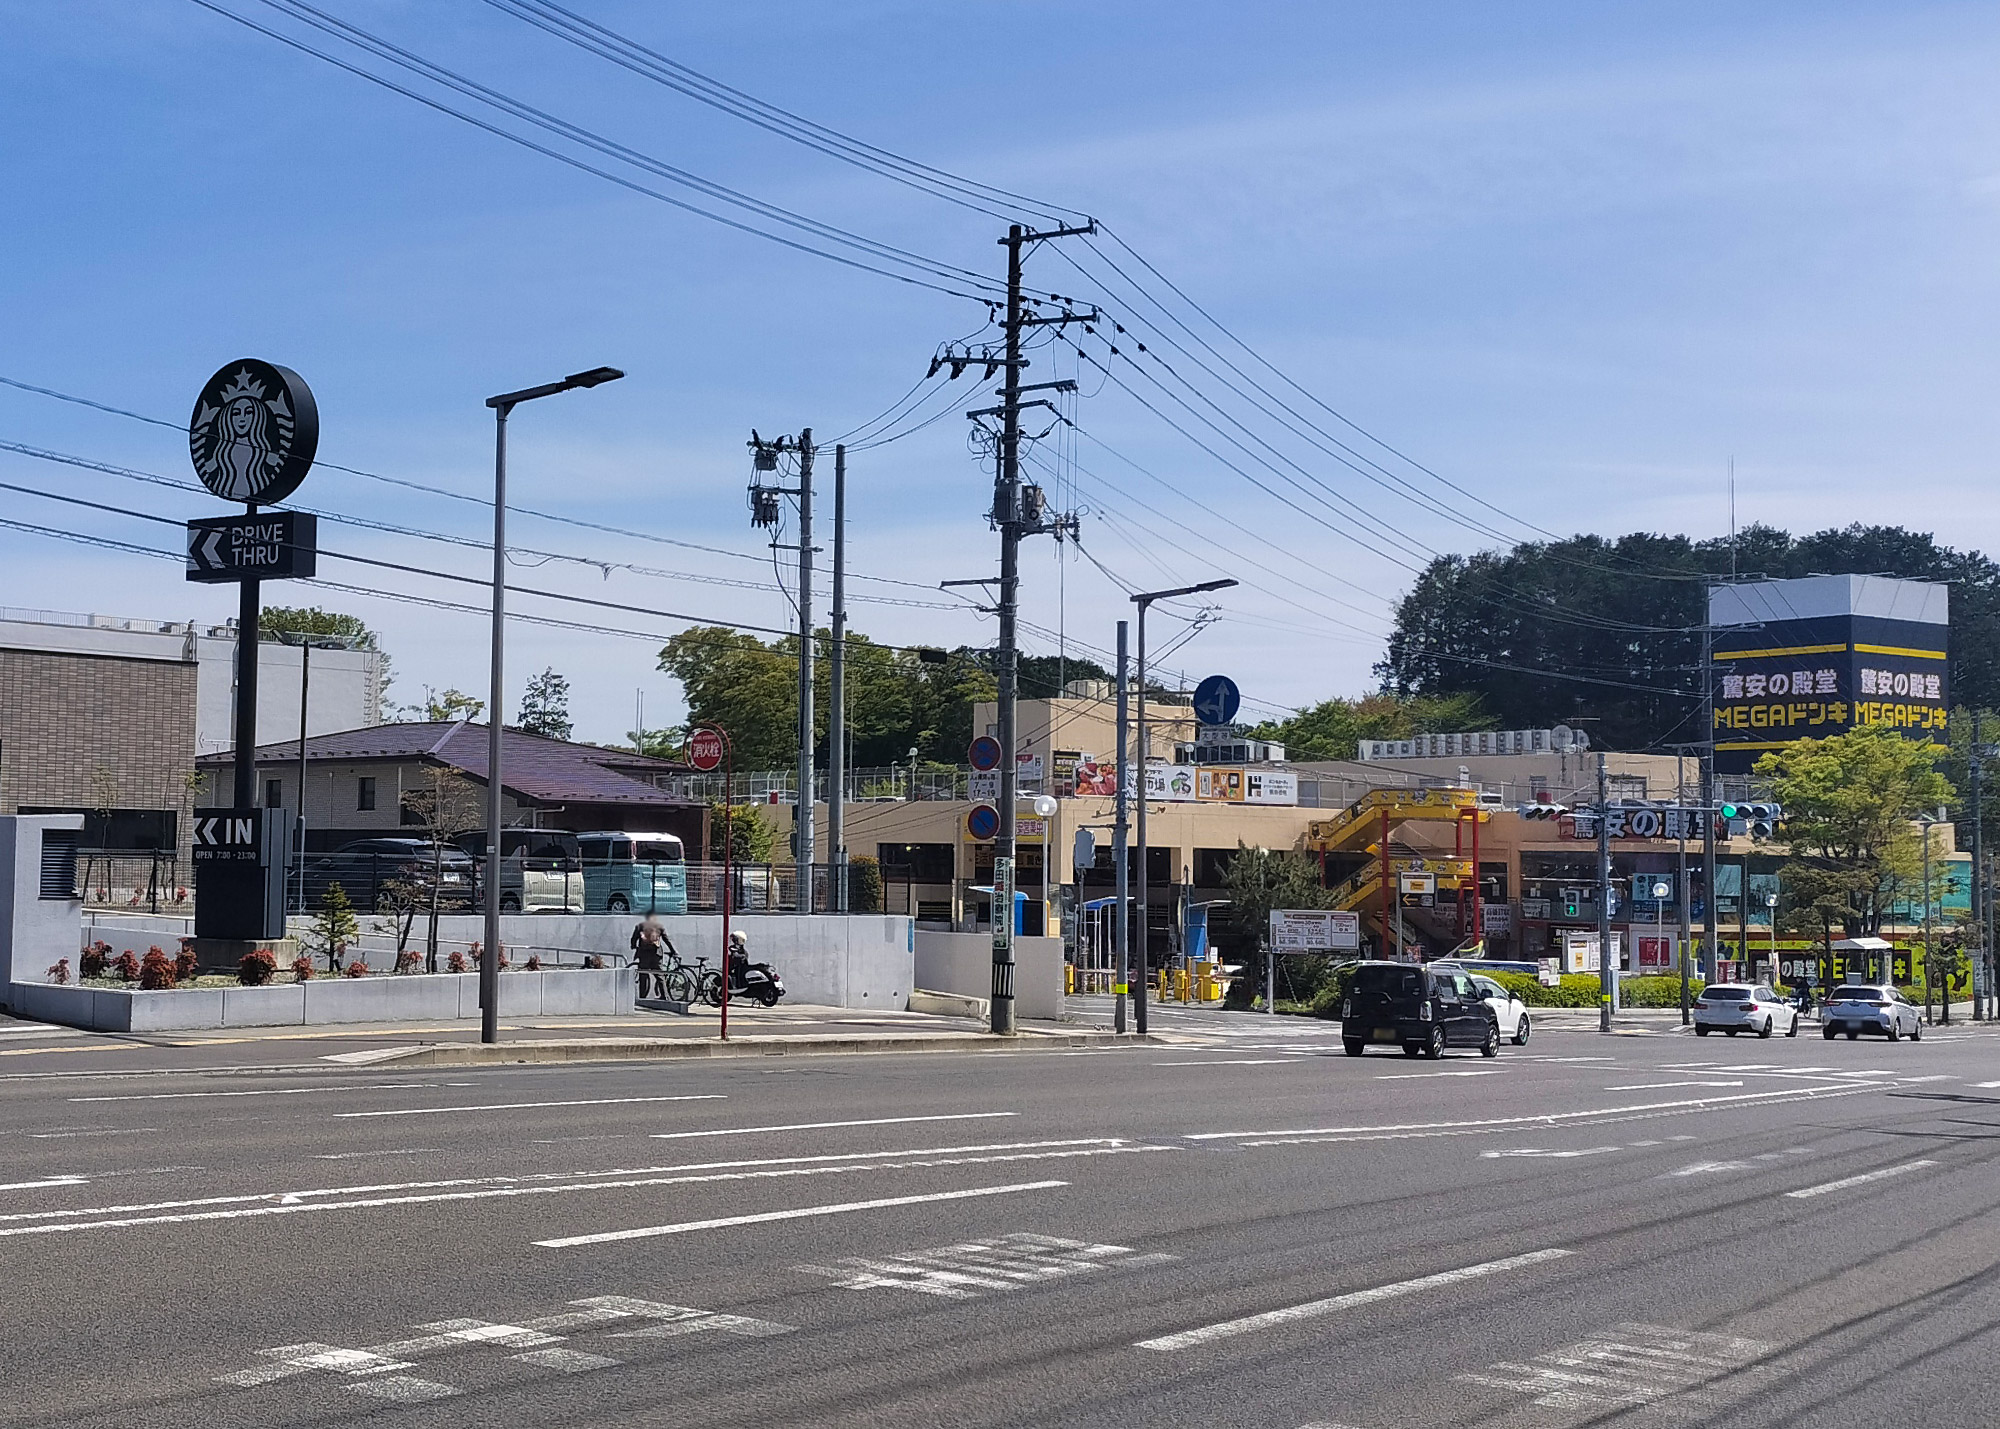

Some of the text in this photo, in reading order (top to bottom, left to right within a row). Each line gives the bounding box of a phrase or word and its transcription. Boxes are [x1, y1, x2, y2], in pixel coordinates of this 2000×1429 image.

[231, 524, 284, 546] DRIVE
[231, 545, 279, 566] THRU
[1722, 668, 1838, 699] 驚安の殿堂
[1860, 668, 1941, 699] 驚安の殿堂
[1714, 701, 1848, 729] MEGAドンキ
[1854, 701, 1947, 730] MEGAドンキ
[693, 742, 720, 758] 消火栓
[225, 818, 253, 845] IN
[195, 850, 213, 859] OPEN
[216, 850, 231, 859] 7:00
[237, 851, 257, 860] 23:00
